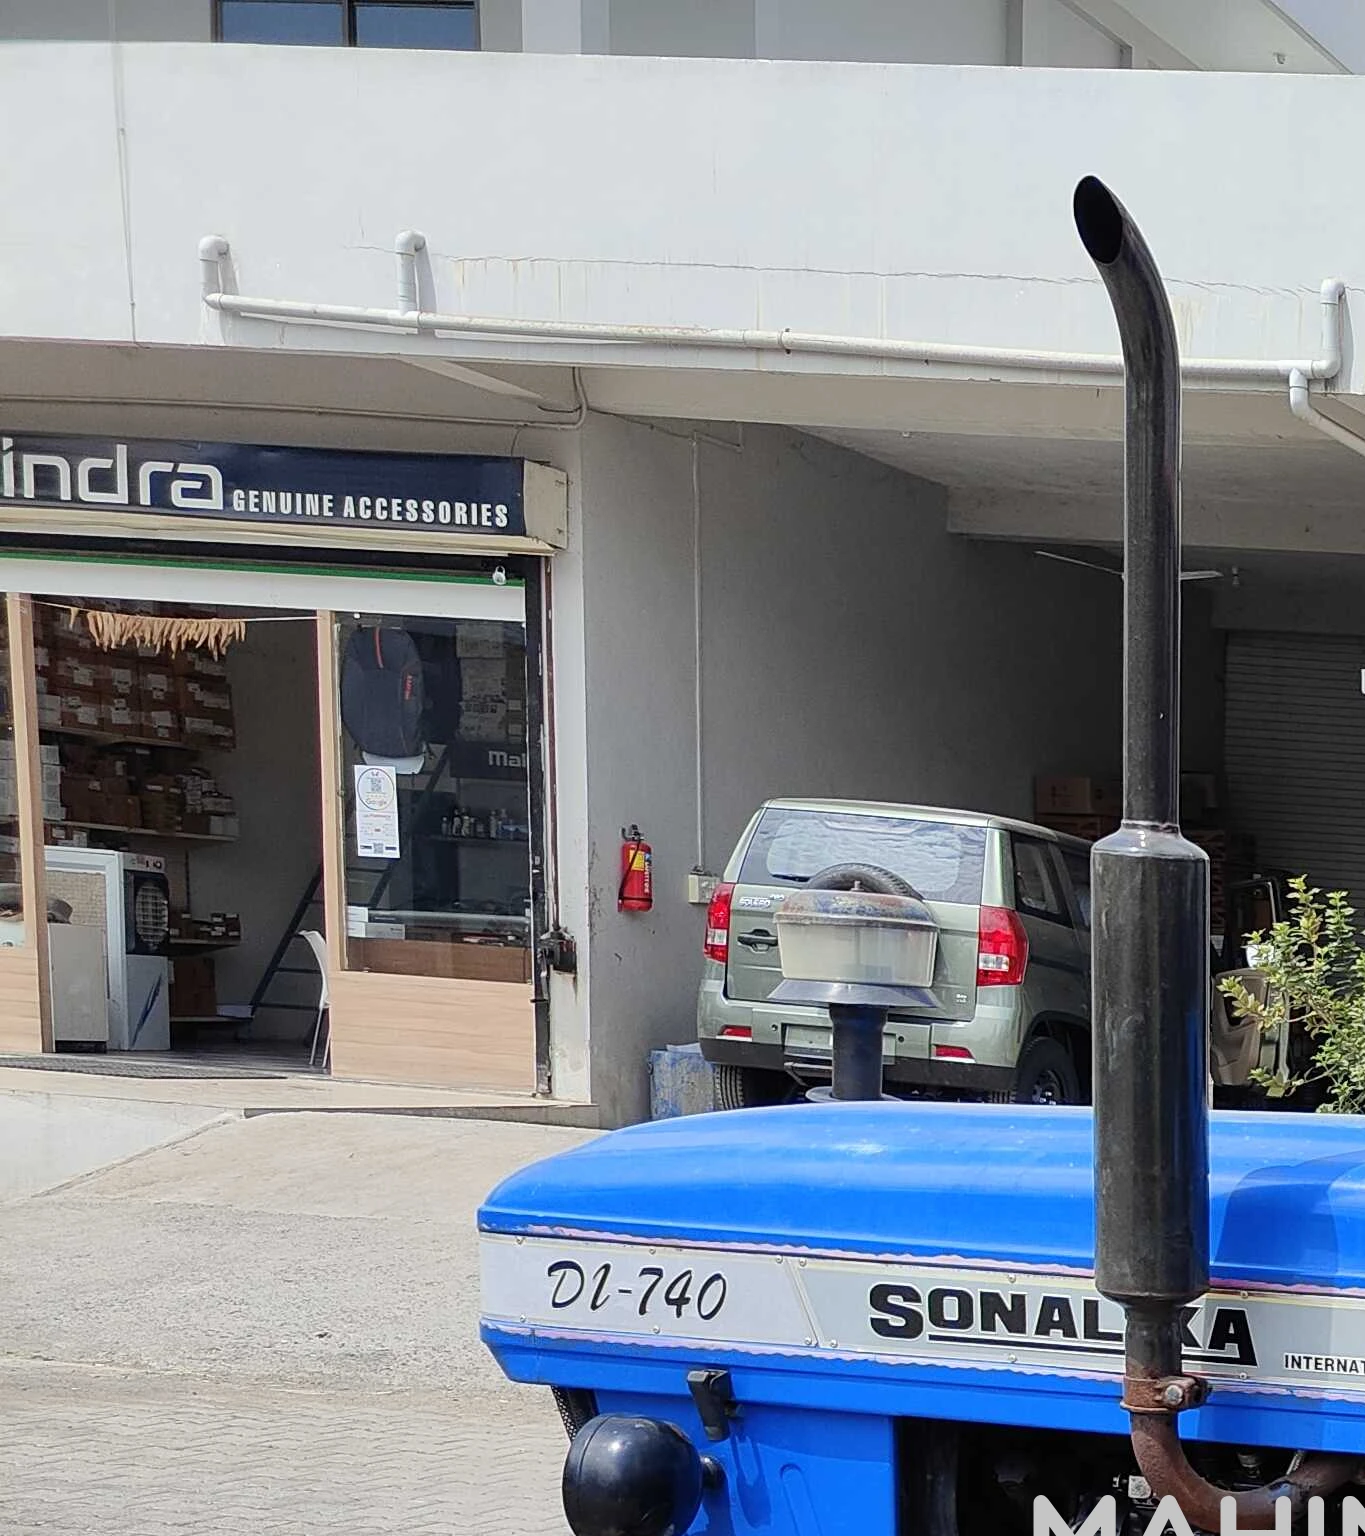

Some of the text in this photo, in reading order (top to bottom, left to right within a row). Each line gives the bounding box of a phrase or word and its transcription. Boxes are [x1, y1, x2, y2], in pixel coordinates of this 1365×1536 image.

[232, 489, 509, 528] GENUINE ACCESSORIES
[547, 1260, 727, 1320] DI-740
